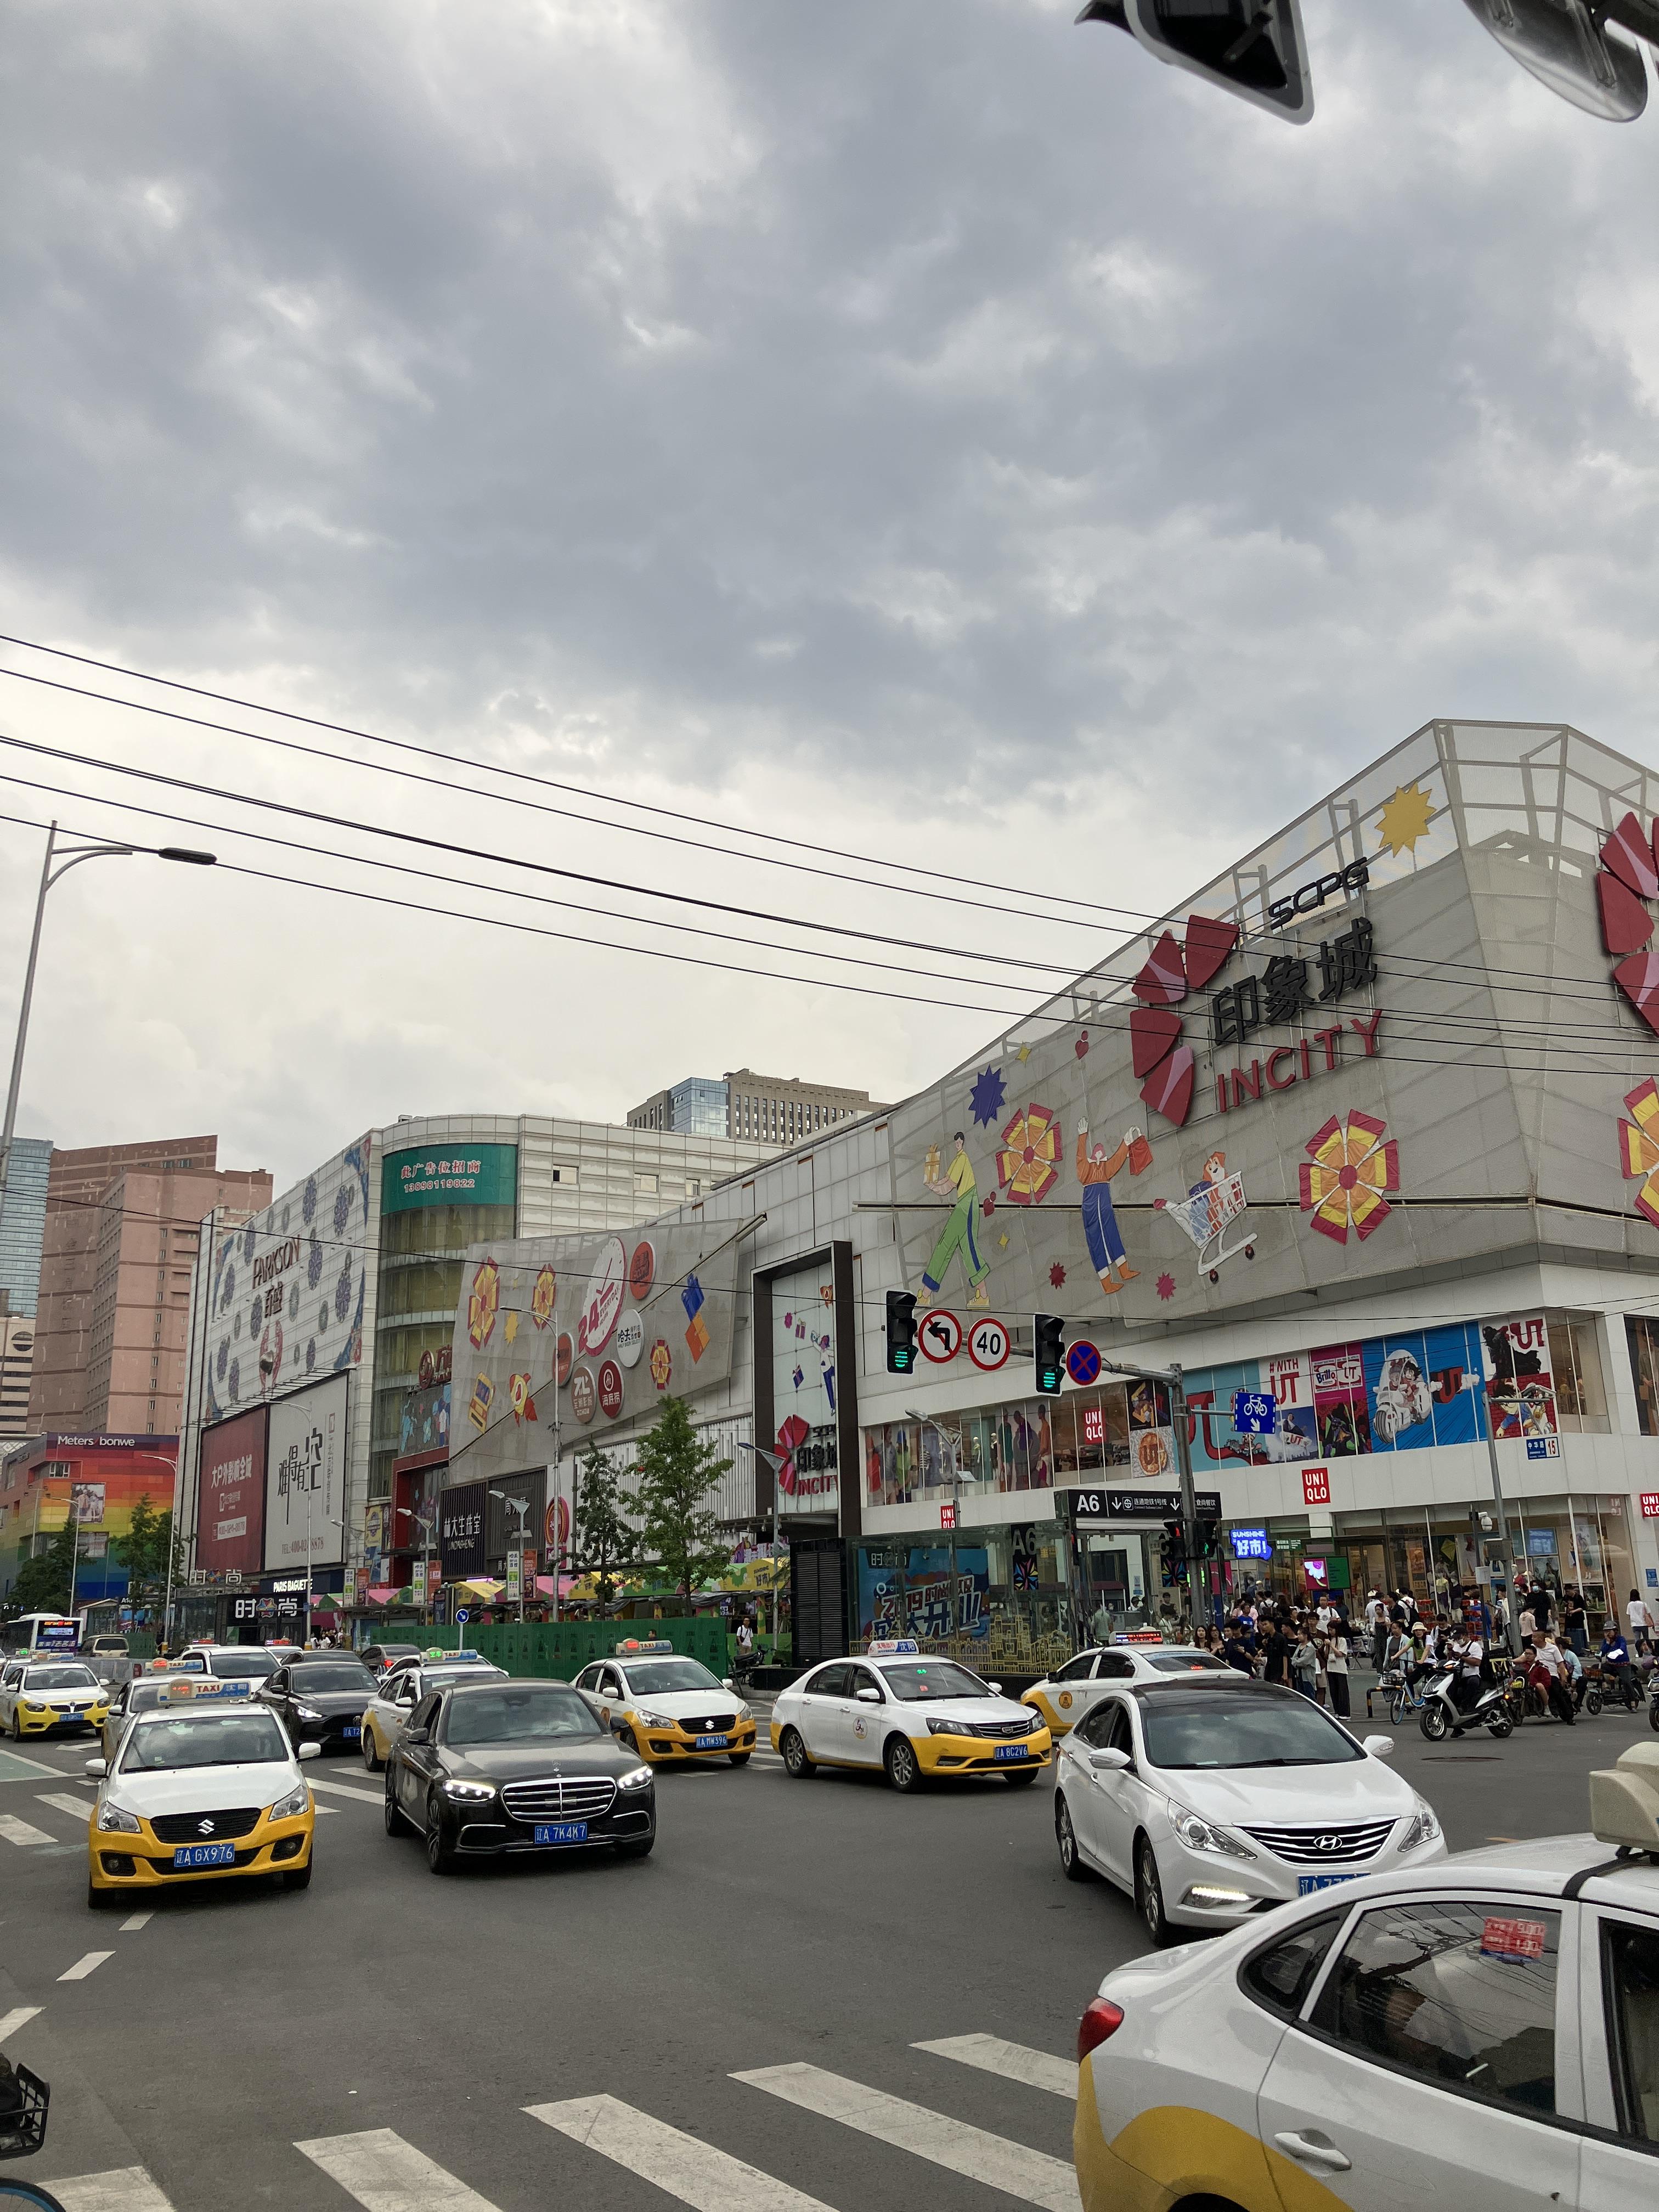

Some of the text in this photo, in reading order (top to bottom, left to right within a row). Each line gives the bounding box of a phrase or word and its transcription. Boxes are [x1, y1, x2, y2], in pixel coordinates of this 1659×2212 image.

[1268, 856, 1370, 930] SCPG
[1212, 916, 1378, 1045] 印象城
[1217, 1009, 1382, 1112] INCITY
[401, 1159, 481, 1179] 此广告位招商
[404, 1178, 475, 1193] 13898119822
[252, 1234, 300, 1289] PARKSON
[264, 1282, 283, 1318] 百盛
[977, 1331, 1001, 1355] 40
[1316, 1369, 1335, 1384] Brillo
[1269, 1372, 1300, 1405] UT
[602, 1391, 620, 1407] 海底捞
[1085, 1410, 1102, 1425] UNI
[813, 1424, 837, 1438] SCP
[1086, 1425, 1103, 1441] QLO
[1290, 1434, 1304, 1445] UT
[1548, 1440, 1556, 1455] 15
[211, 1454, 252, 1489] 大户外影响全城
[1305, 1472, 1324, 1486] UNI
[1134, 1498, 1167, 1506] 连通地铁1号线
[1307, 1487, 1327, 1502] QLO
[1643, 1496, 1659, 1505] UNI
[1077, 1494, 1099, 1512] A6
[942, 1508, 953, 1519] UNI
[1012, 1527, 1036, 1555] A6
[274, 1581, 287, 1593] PARIS
[900, 1641, 916, 1651] 沈阳
[196, 1685, 219, 1693] TAXI
